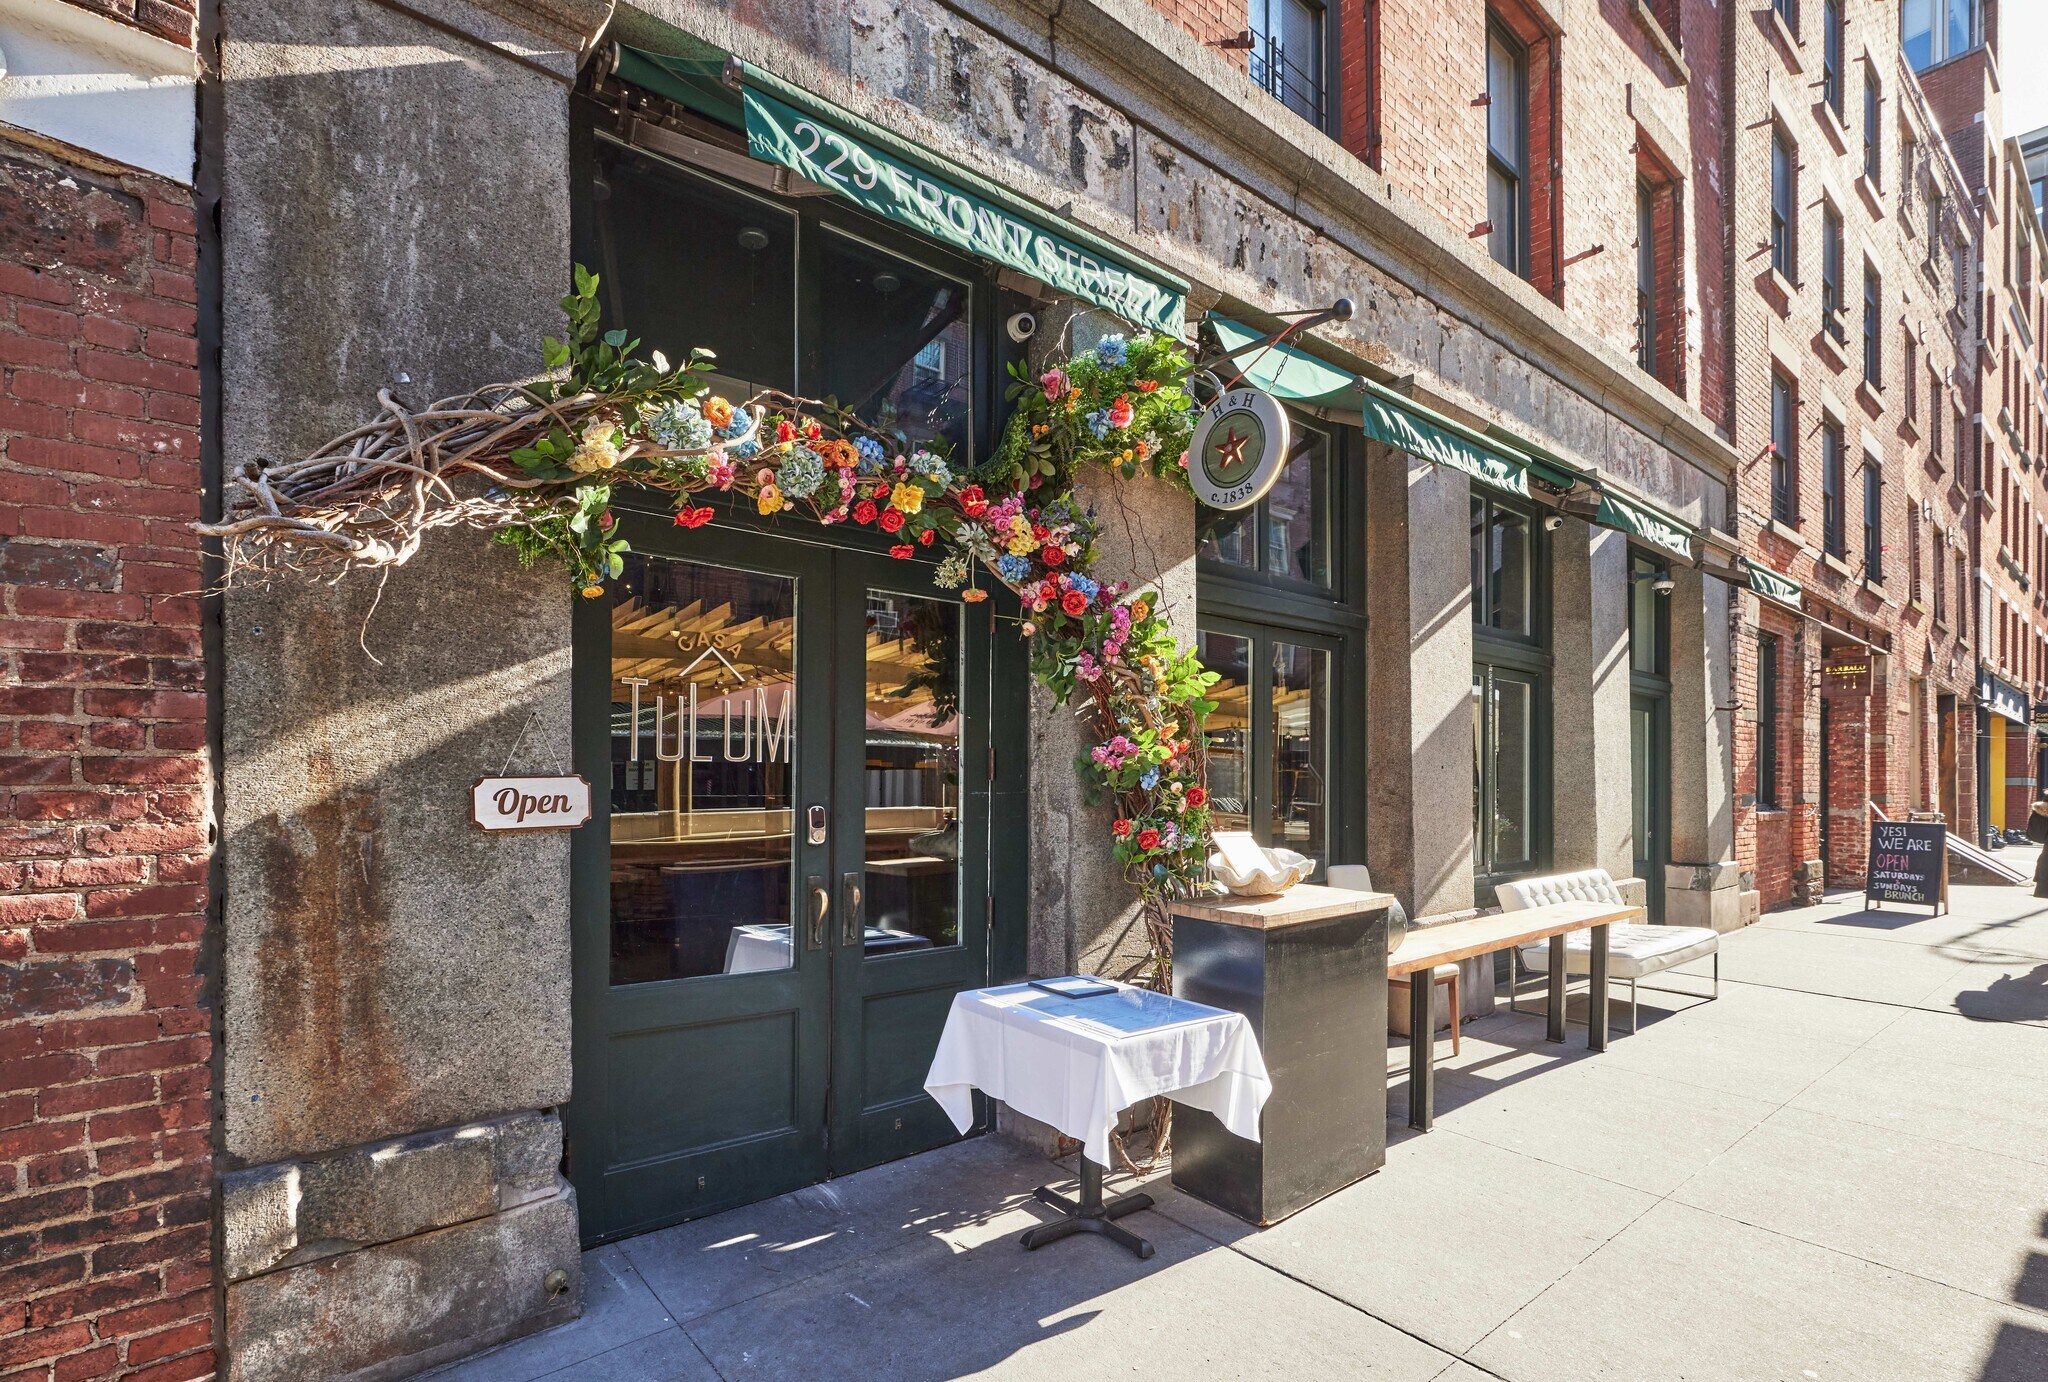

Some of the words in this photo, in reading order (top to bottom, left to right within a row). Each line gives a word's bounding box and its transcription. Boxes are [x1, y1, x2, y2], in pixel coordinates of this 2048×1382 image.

[793, 122, 878, 190] 229
[890, 165, 1027, 258] FRONT
[1037, 236, 1161, 317] STREET
[1211, 402, 1224, 420] H
[1228, 395, 1238, 407] &
[1241, 392, 1256, 409] H
[678, 632, 742, 659] CASA
[621, 677, 790, 763] TULUM
[492, 787, 573, 823] Open
[1880, 826, 1907, 837] YES!
[1878, 837, 1904, 850] WE
[1906, 838, 1932, 851] ARE
[1876, 853, 1909, 871] OPEN
[1873, 870, 1925, 880] SATURDAYS
[1873, 882, 1918, 892] SUNDAYS
[1884, 889, 1925, 902] BRUNCH
